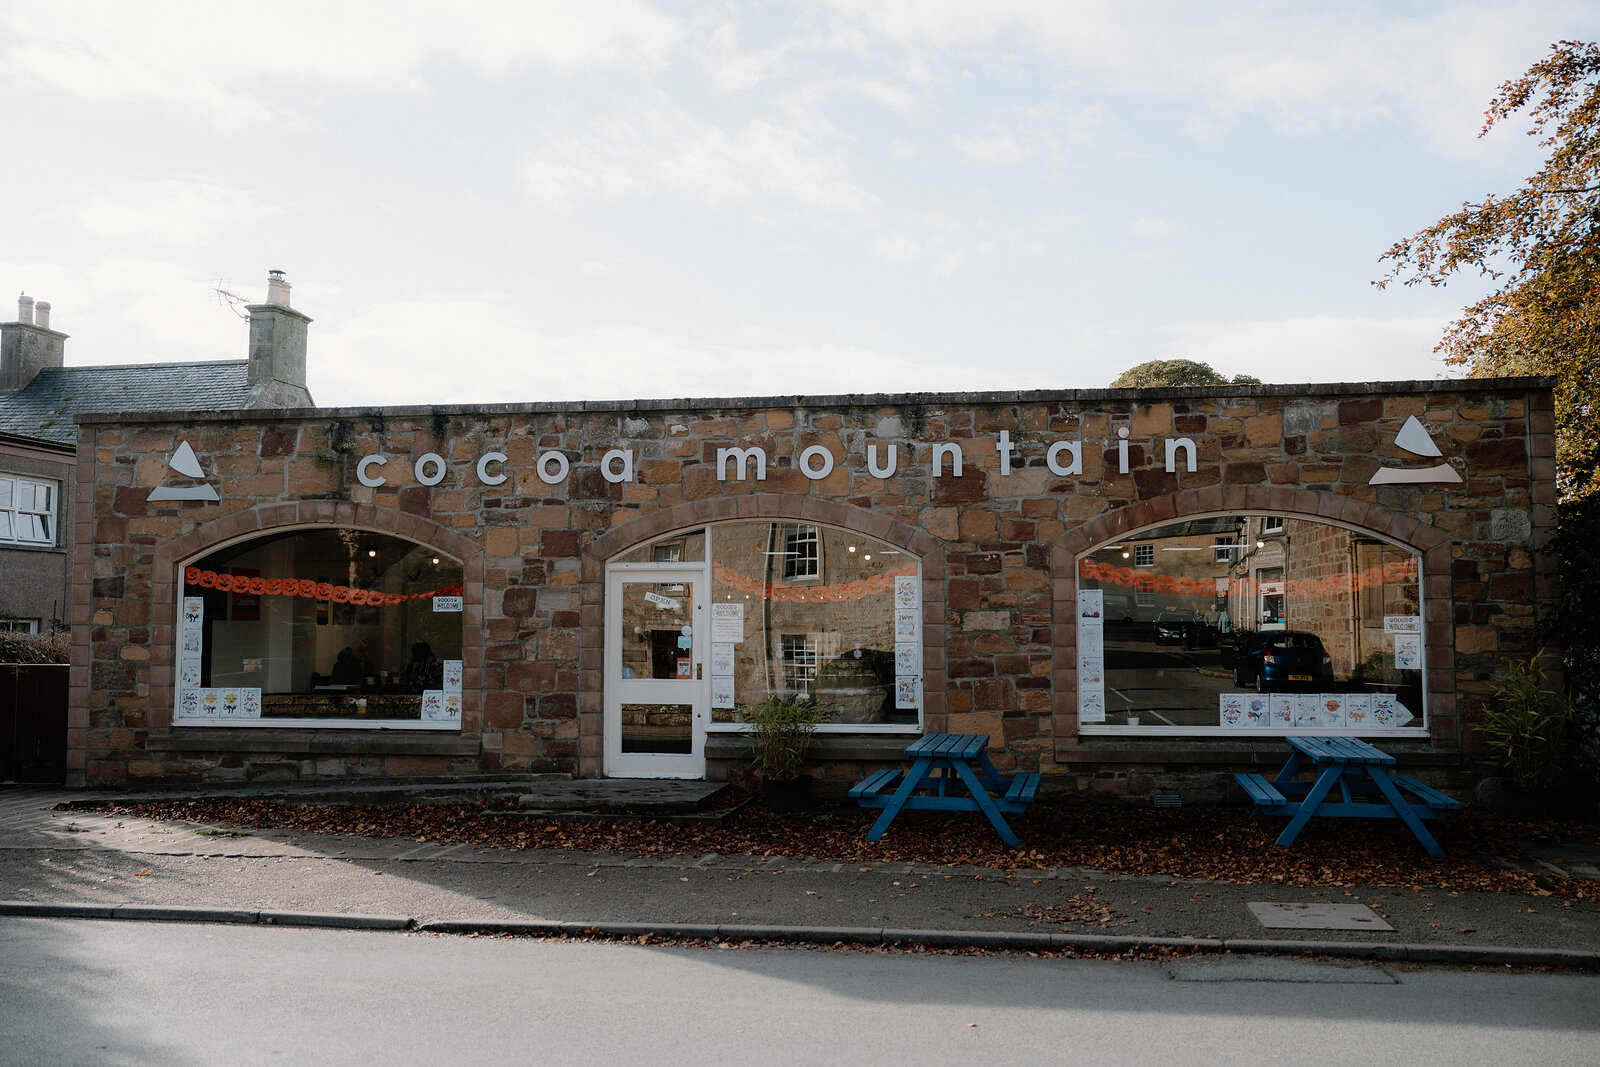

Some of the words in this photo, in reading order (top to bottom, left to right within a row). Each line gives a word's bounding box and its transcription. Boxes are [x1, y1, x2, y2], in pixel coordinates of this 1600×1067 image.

[356, 447, 634, 488] cocoa
[716, 426, 1198, 482] mountain
[650, 594, 671, 605] OPEN
